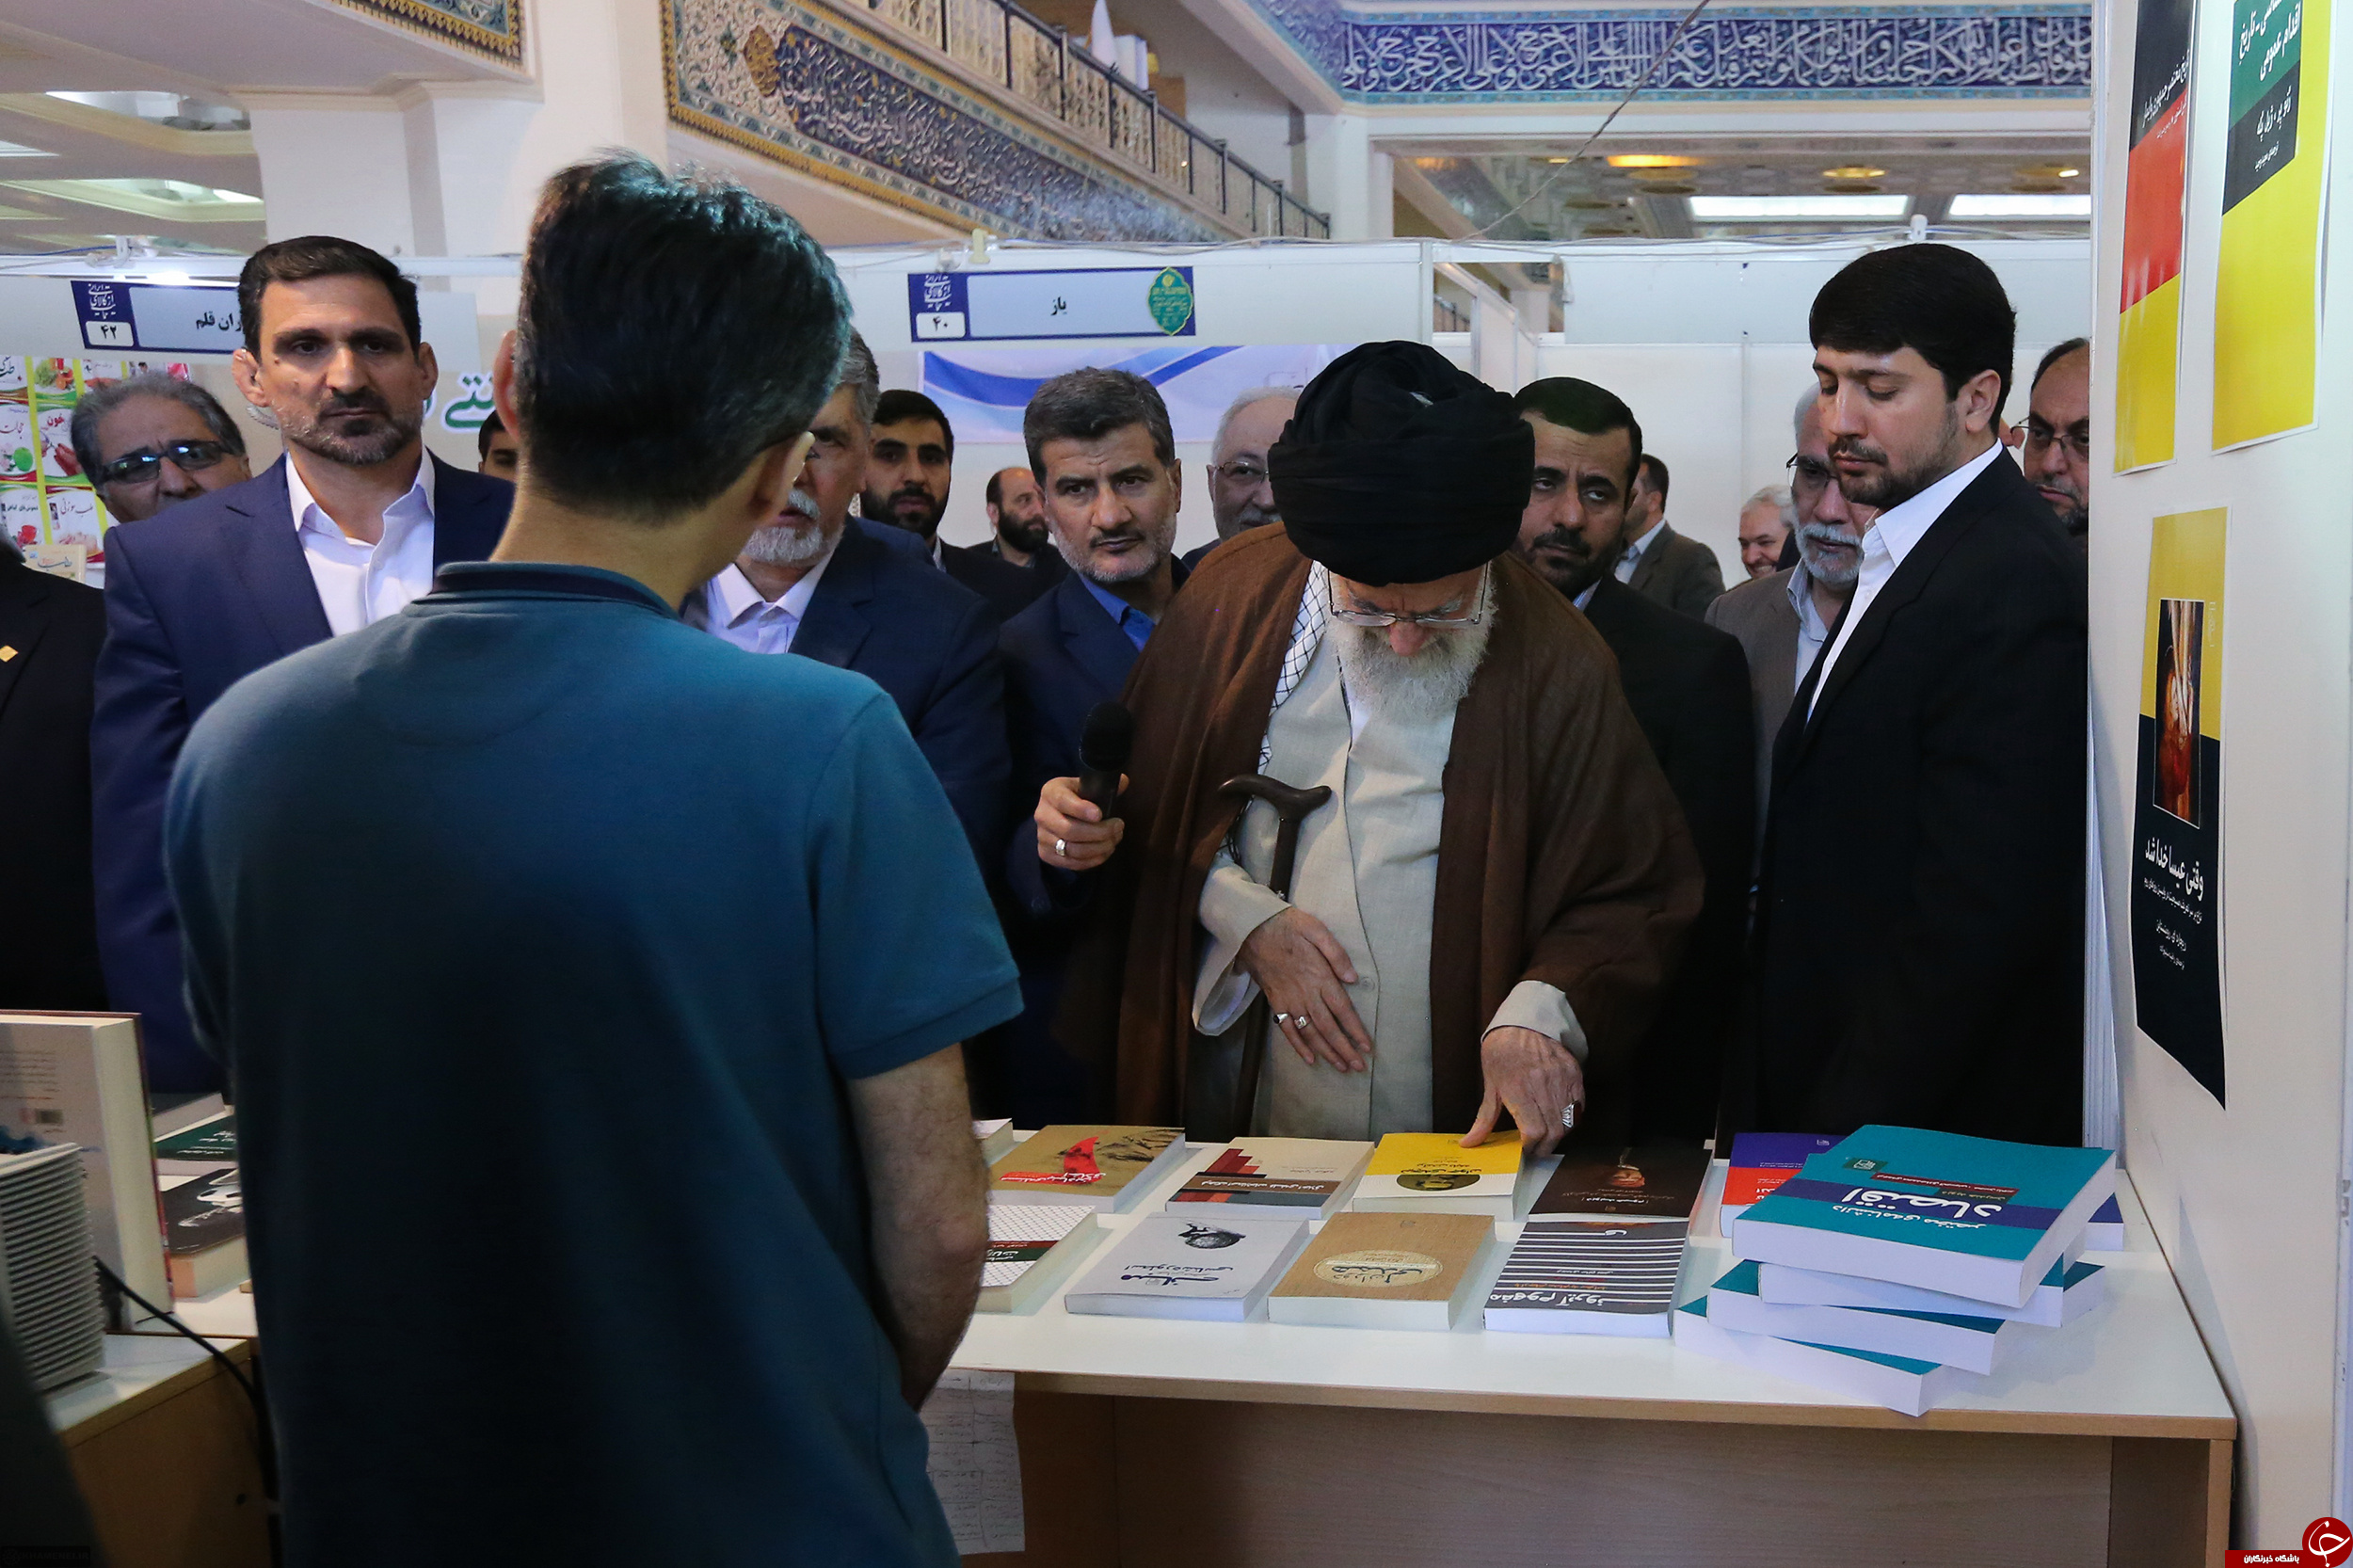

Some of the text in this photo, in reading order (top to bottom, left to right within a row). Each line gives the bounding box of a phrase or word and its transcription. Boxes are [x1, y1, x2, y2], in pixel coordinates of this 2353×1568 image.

[2260, 32, 2282, 81] عمومی
[196, 311, 216, 330] قلم
[932, 315, 949, 331] ۴۰
[100, 324, 118, 340] ۴۲
[2145, 837, 2203, 902] وقتی عیسا خدا شد
[1841, 1187, 2003, 1219] اقتصاد
[1923, 1218, 1988, 1230] مختصر
[1489, 1291, 1556, 1304] مفهوم
